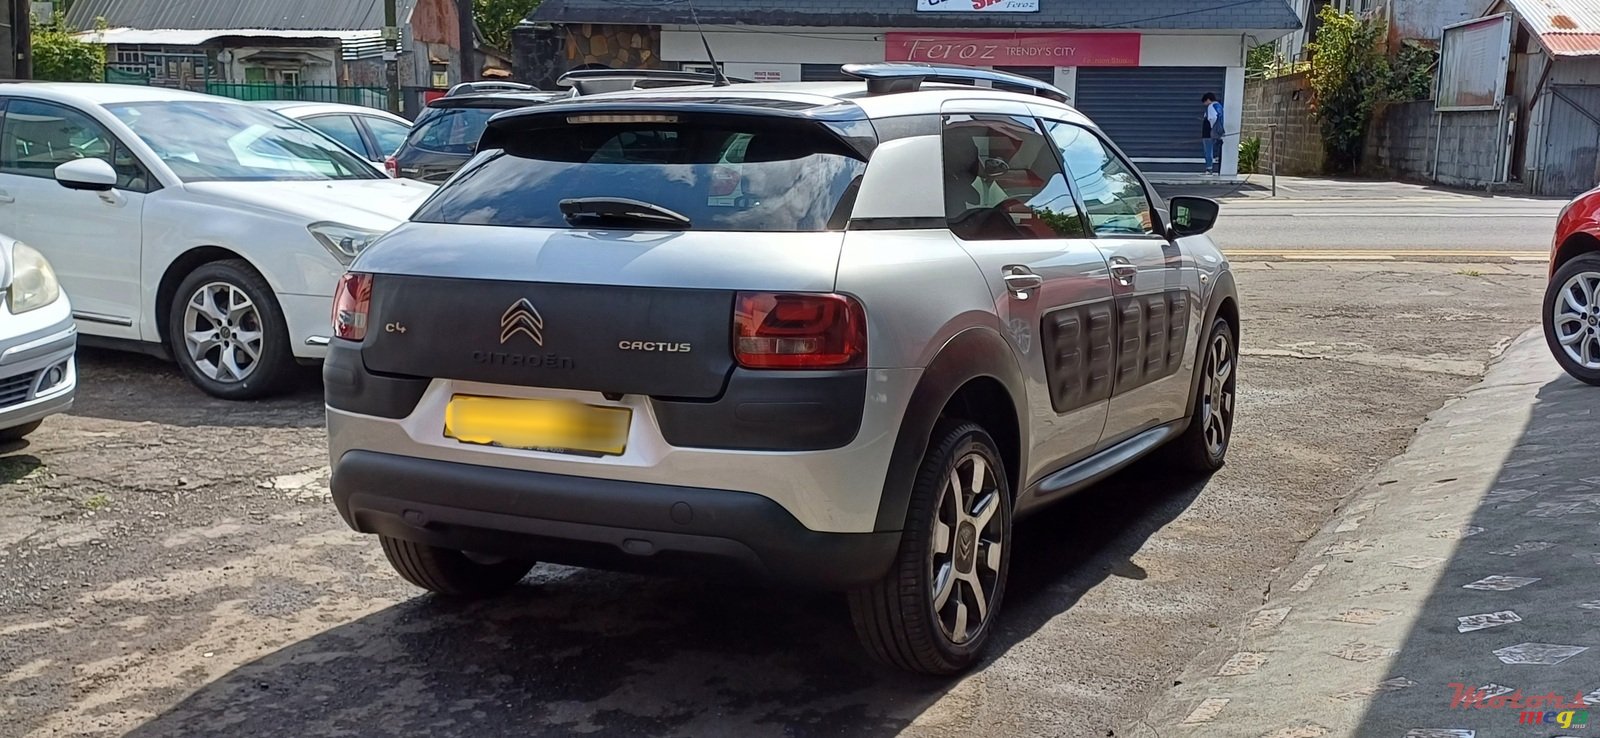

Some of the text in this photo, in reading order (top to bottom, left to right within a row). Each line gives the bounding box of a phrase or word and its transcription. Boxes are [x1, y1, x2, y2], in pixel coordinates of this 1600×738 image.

[1006, 46, 1076, 56] TRENDY'S CITY
[385, 322, 406, 334] C4
[618, 340, 691, 352] CACTUS
